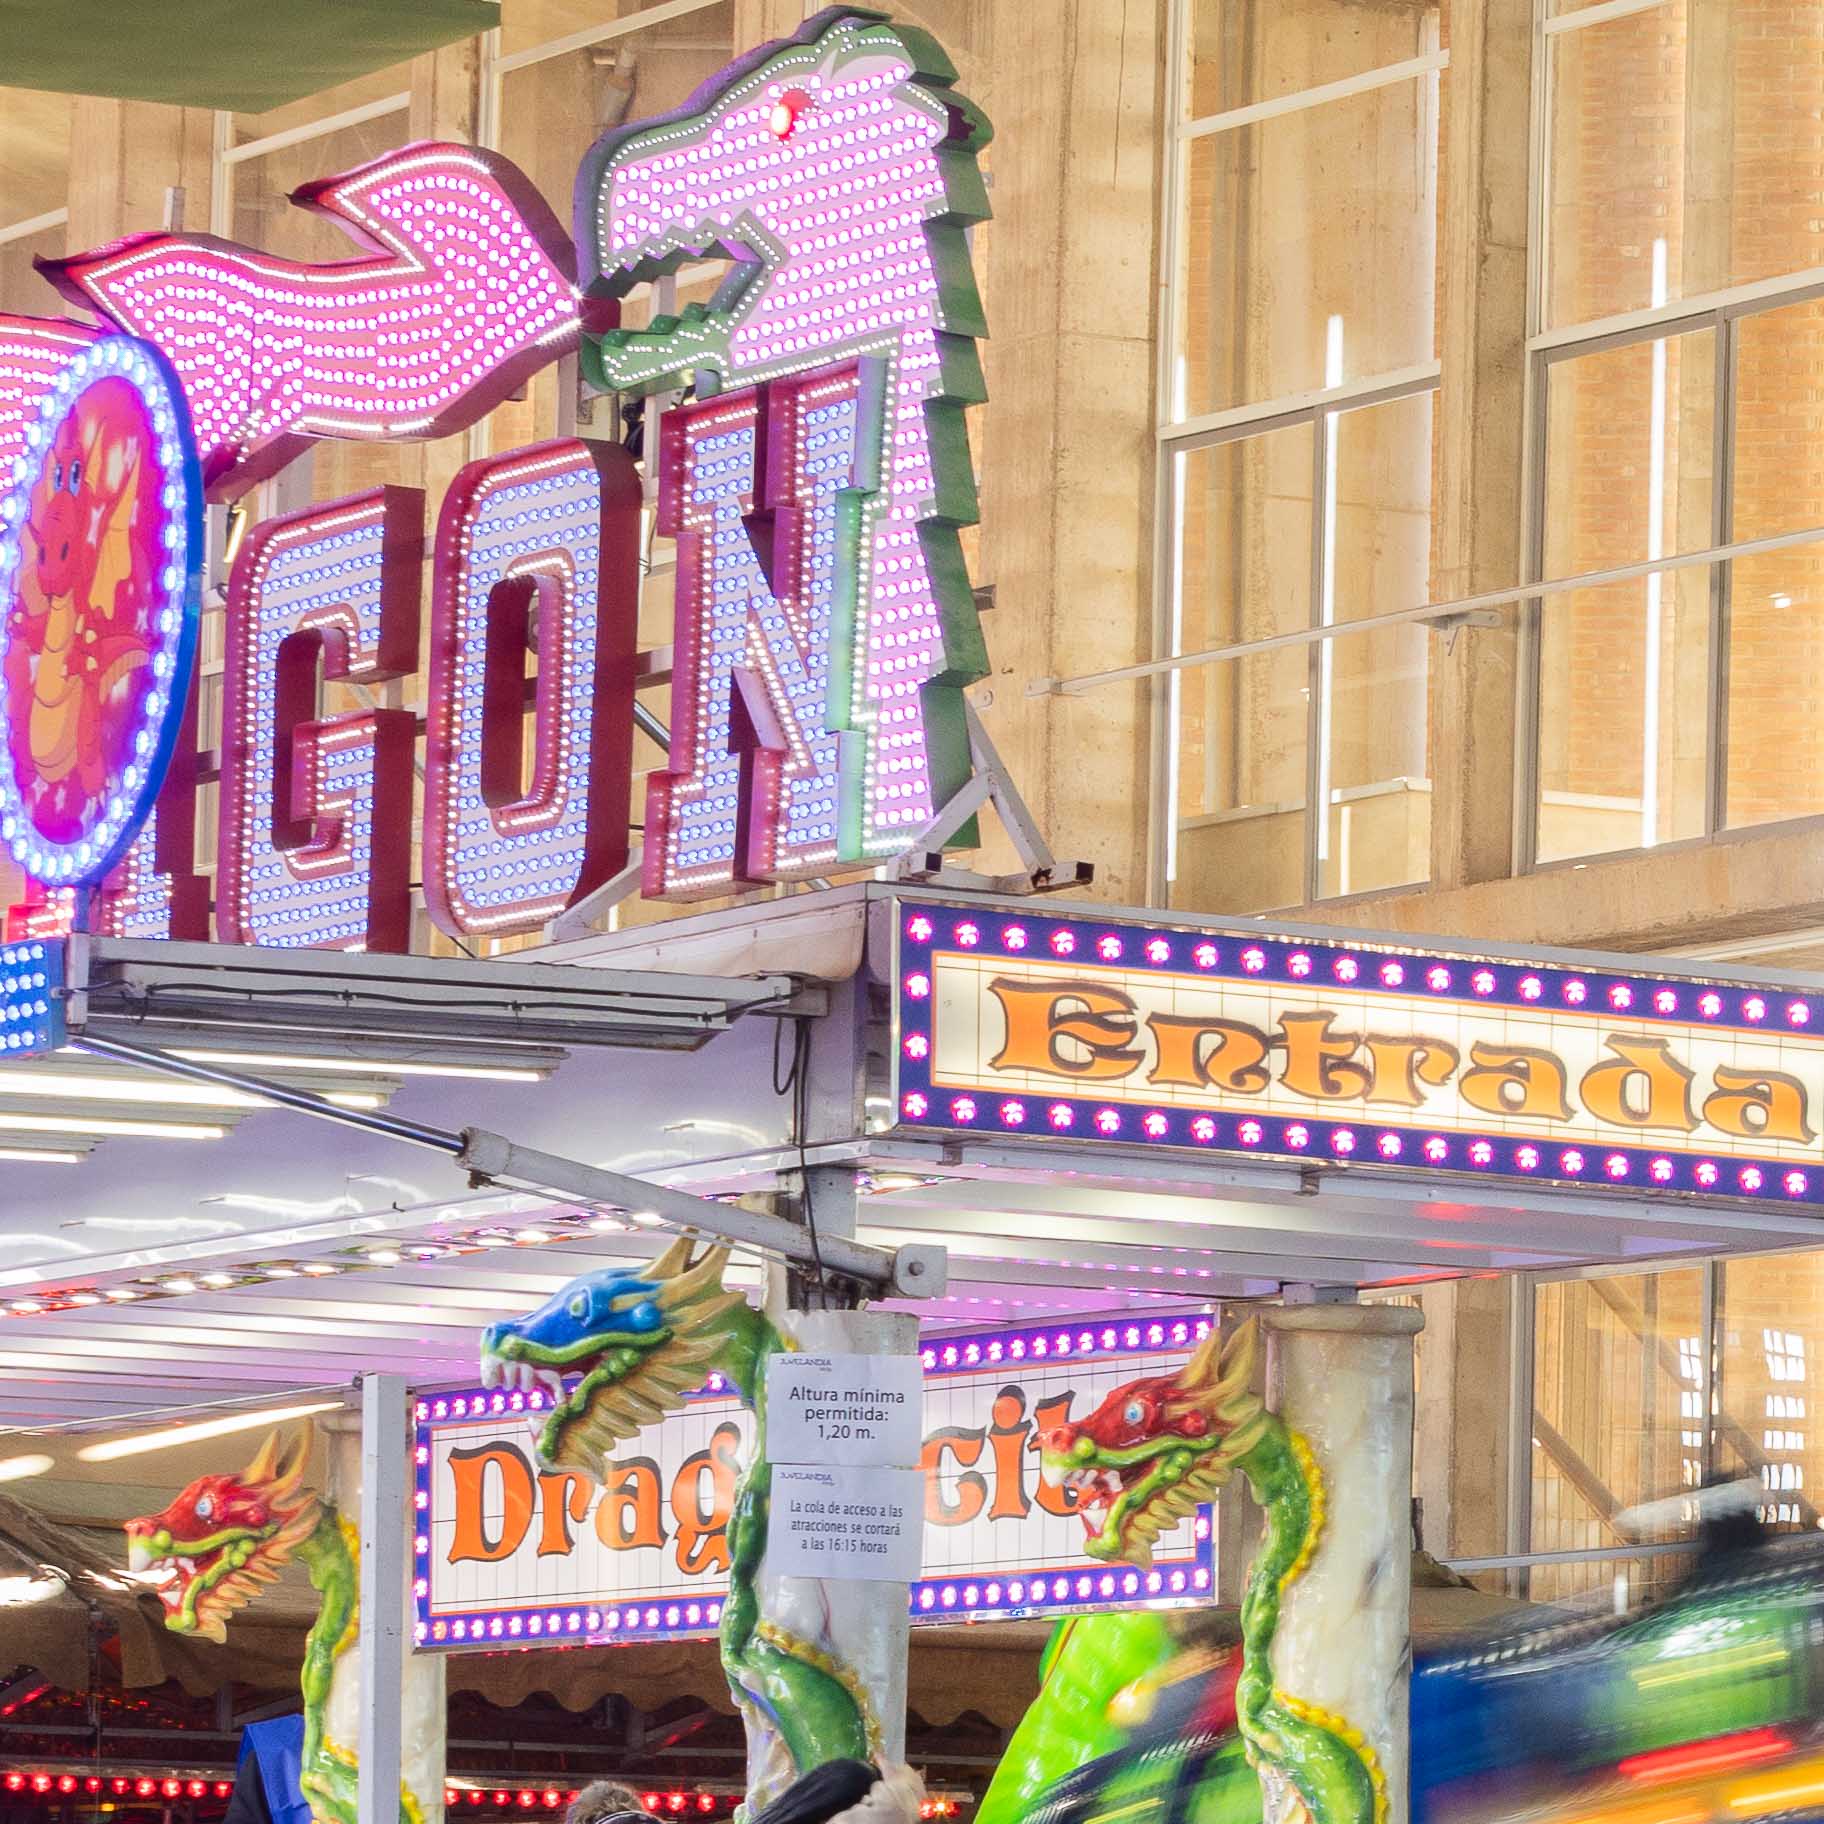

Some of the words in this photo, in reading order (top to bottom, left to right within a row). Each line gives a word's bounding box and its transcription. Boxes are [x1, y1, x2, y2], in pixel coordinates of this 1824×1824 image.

[986, 976, 1817, 1144] Entrada
[790, 1386, 838, 1402] Altura
[844, 1388, 904, 1404] mínima
[804, 1406, 889, 1422] permitida:
[818, 1425, 851, 1440] 1,20
[856, 1428, 875, 1439] m.
[447, 1384, 1100, 1575] Dragcit
[791, 1501, 801, 1513] La
[805, 1501, 825, 1514] cola
[828, 1502, 840, 1515] de
[844, 1505, 876, 1517] acceso
[880, 1506, 886, 1517] a
[889, 1504, 903, 1518] las
[791, 1520, 847, 1534] atracciones
[851, 1524, 862, 1534] se
[865, 1523, 900, 1536] cortará
[802, 1540, 807, 1550] a
[811, 1539, 824, 1550] las
[829, 1539, 857, 1552] 16:15
[860, 1541, 888, 1553] horas
